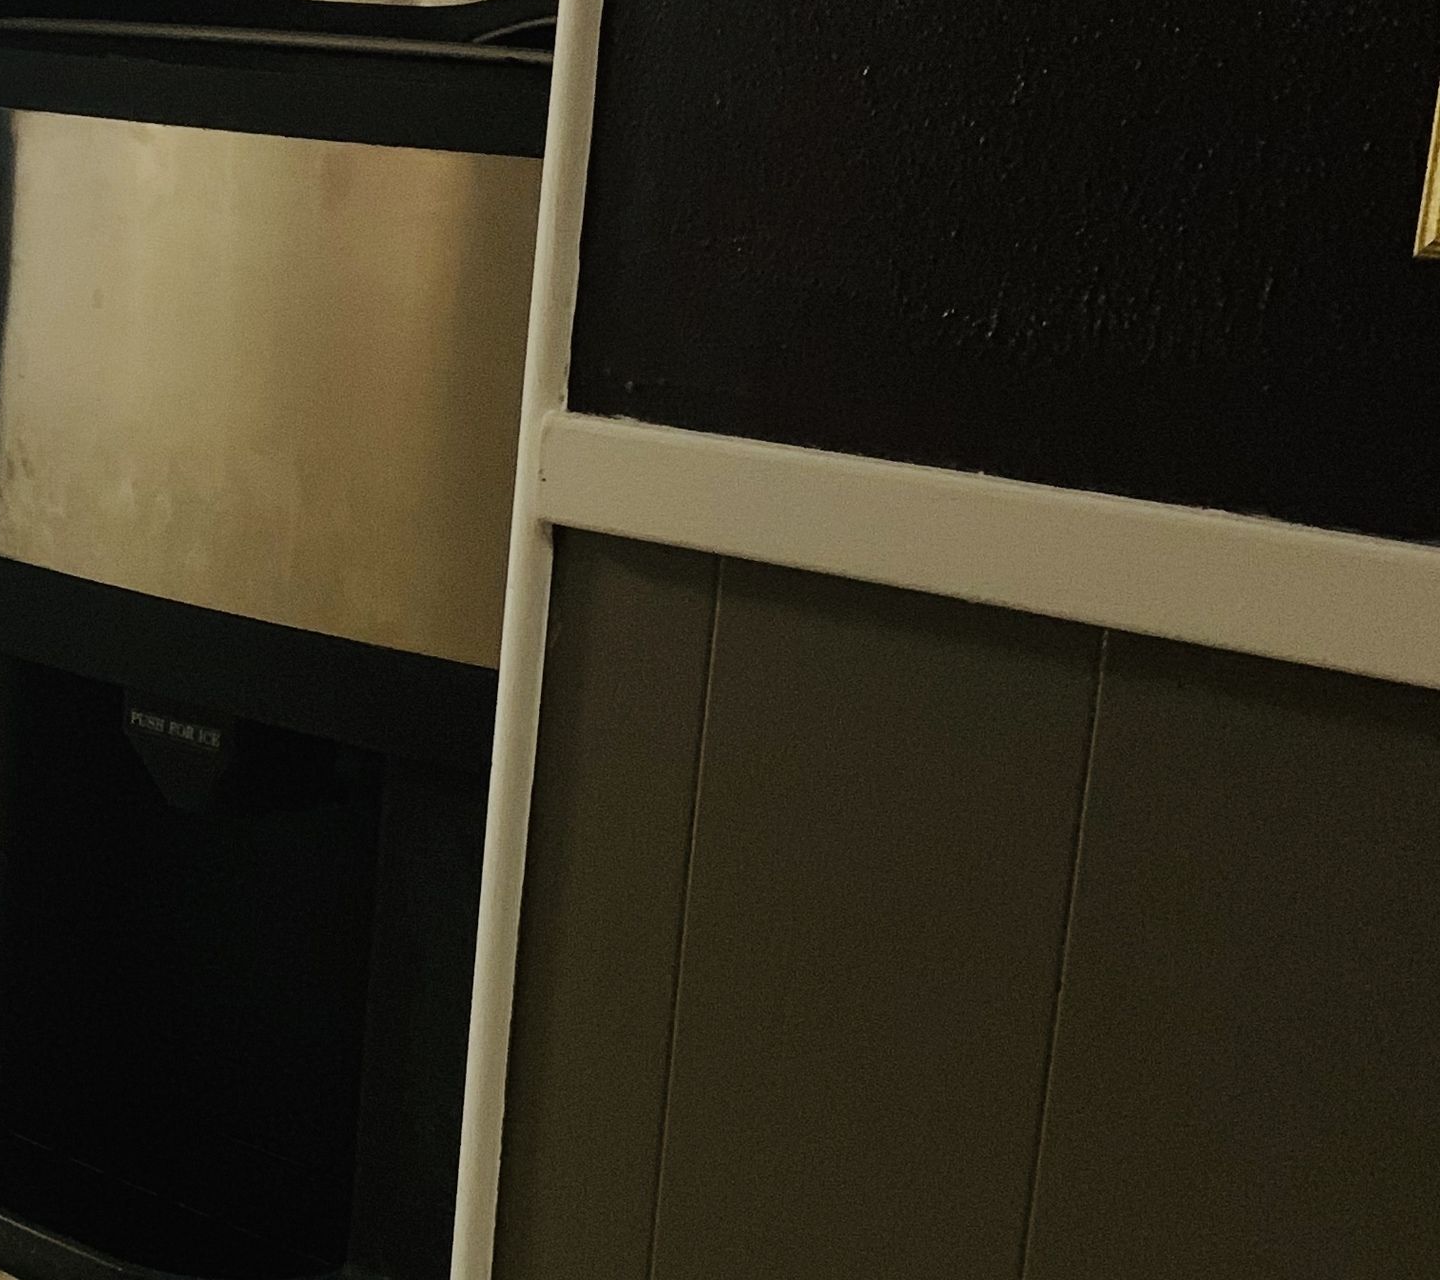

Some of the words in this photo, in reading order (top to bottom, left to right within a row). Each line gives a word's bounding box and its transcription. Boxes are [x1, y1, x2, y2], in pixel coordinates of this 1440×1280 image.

[130, 710, 165, 733] PUSH
[168, 720, 195, 741] FOR
[199, 728, 222, 748] ICE
